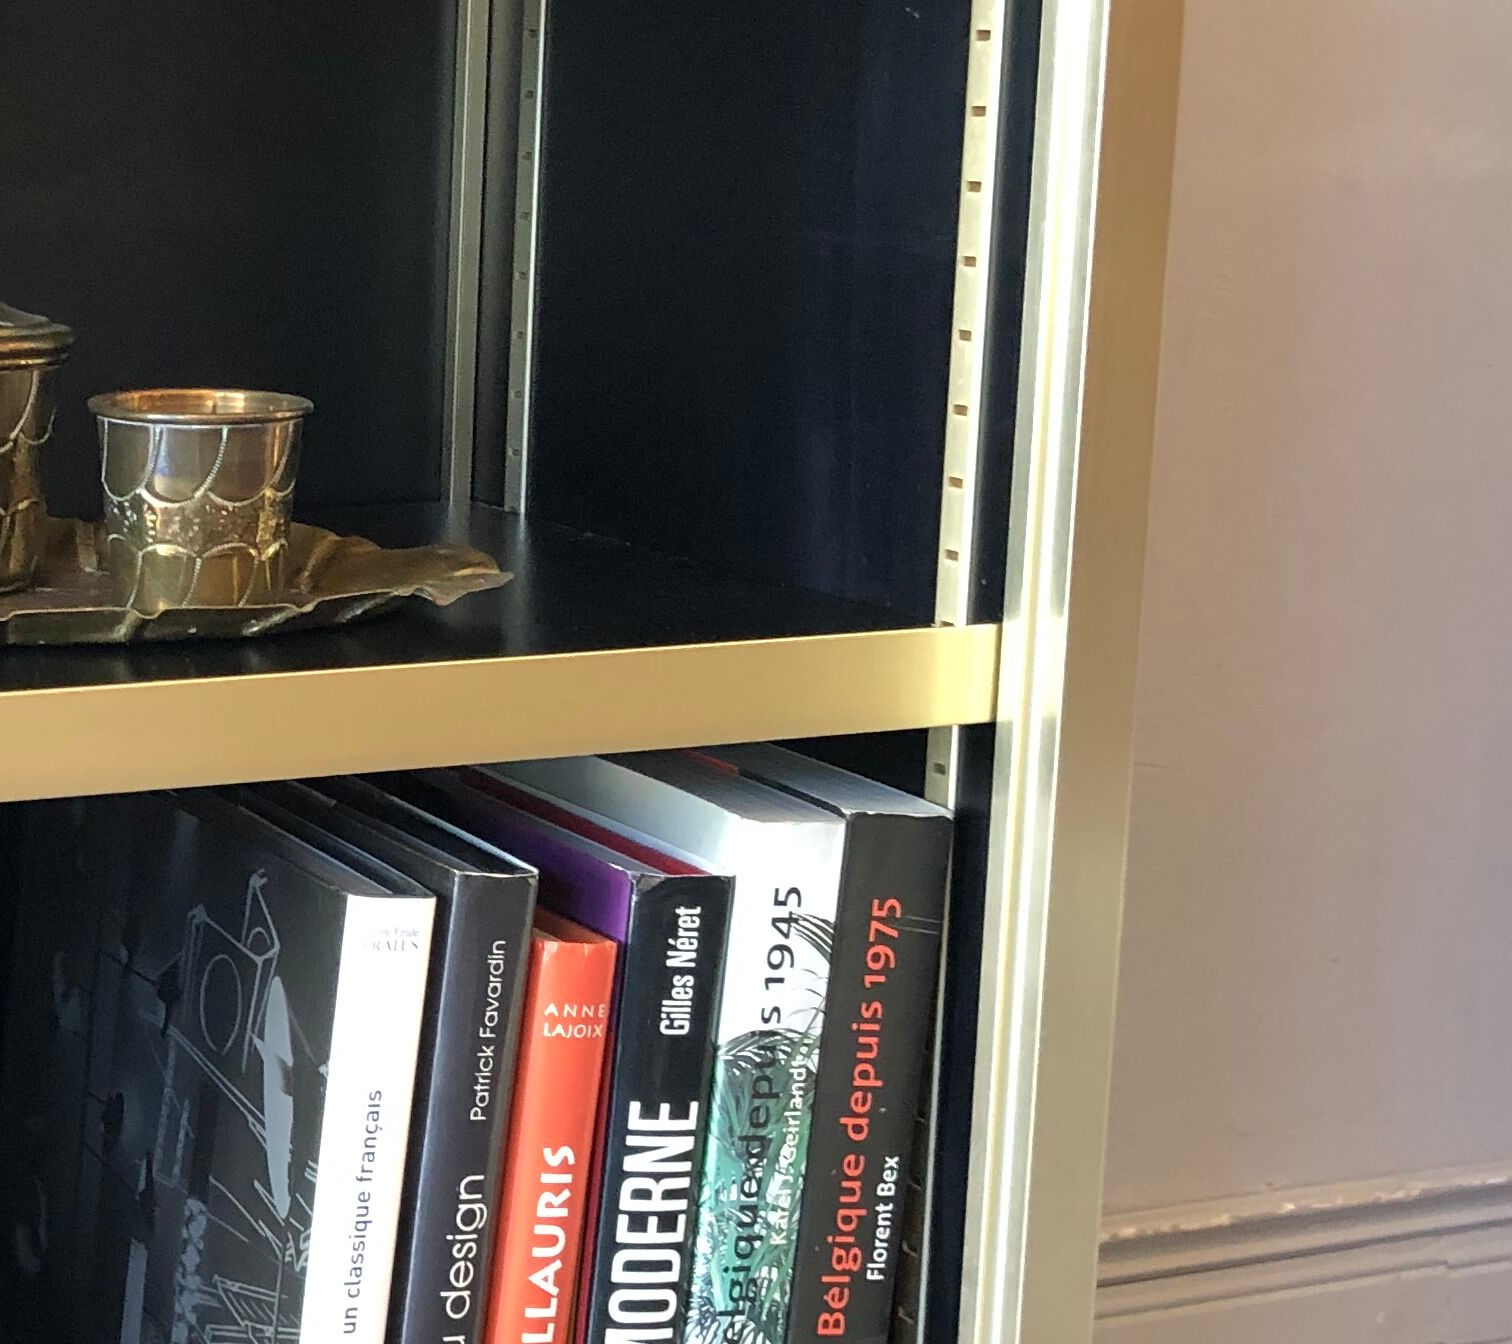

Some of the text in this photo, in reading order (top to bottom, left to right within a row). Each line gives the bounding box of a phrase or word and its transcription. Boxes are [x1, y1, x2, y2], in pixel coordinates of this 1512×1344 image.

[659, 905, 702, 1037] Gilles Néret
[764, 886, 803, 991] 1945
[863, 897, 903, 990] 1975
[470, 939, 507, 1121] Patrick Favardin
[543, 1002, 606, 1018] ANNE
[543, 1022, 604, 1039] LAJOIX
[840, 1000, 885, 1142] depuis
[343, 1089, 383, 1335] un classique français
[439, 1173, 487, 1320] design
[817, 1154, 867, 1336] Belgique
[866, 1155, 901, 1281] Florent Bex
